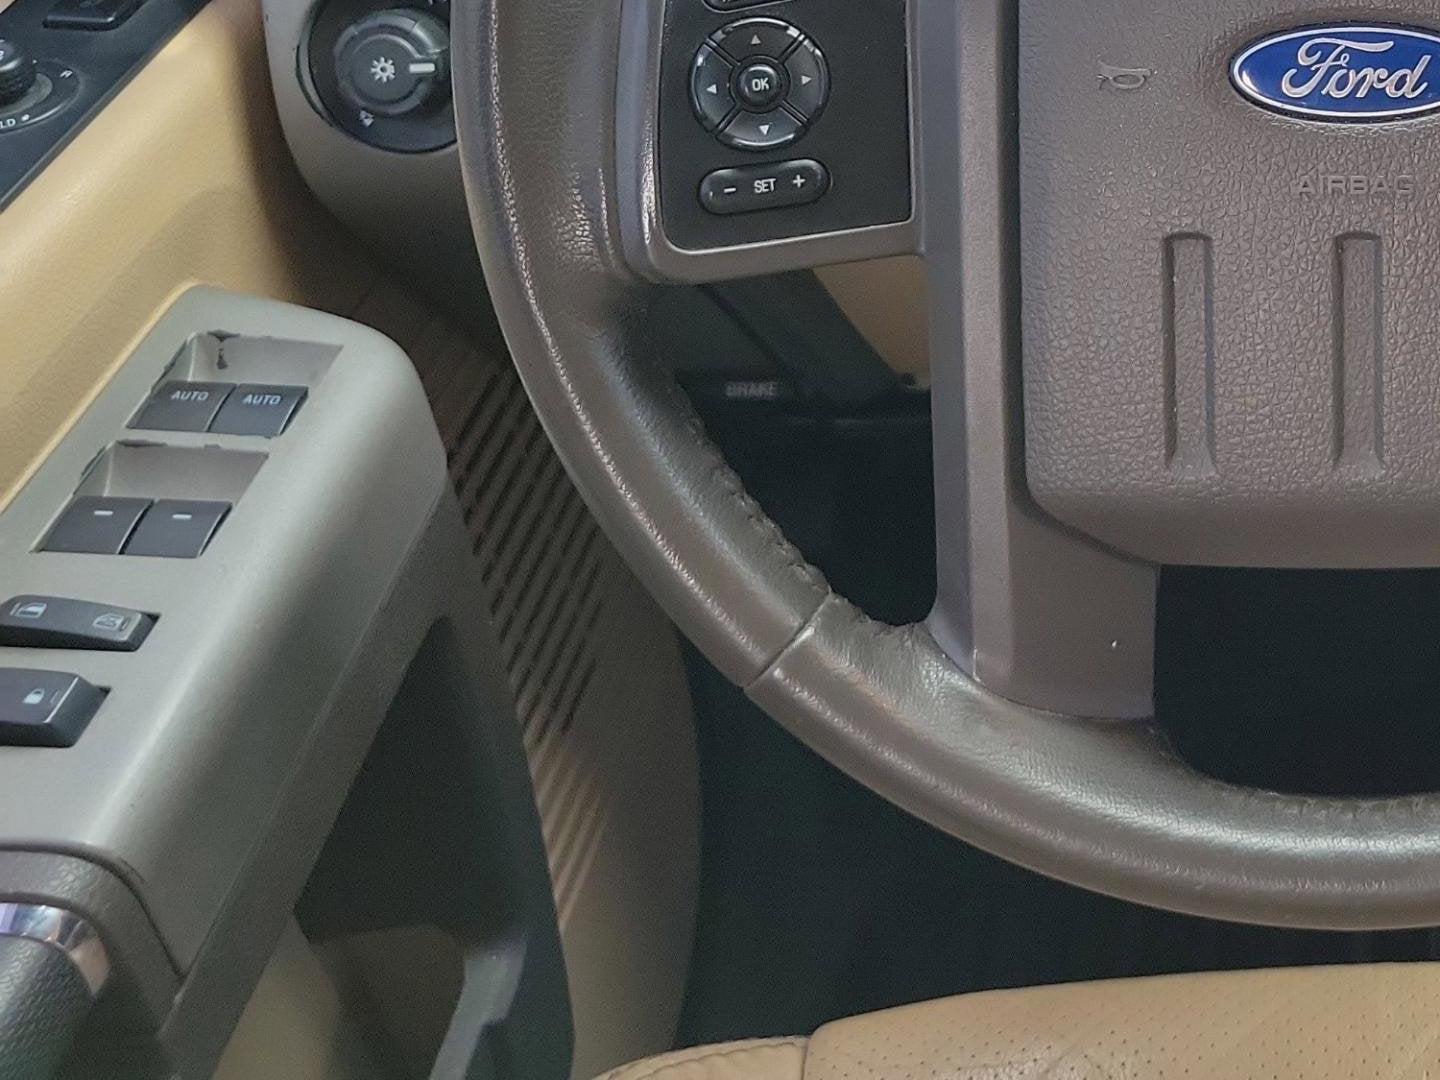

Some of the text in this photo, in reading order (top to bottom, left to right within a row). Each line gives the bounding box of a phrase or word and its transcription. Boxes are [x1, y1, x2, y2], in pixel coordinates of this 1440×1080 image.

[1281, 37, 1432, 100] Ford
[752, 78, 770, 92] OK
[0, 118, 16, 128] LD
[753, 178, 776, 193] SET
[1297, 175, 1416, 196] AIRBAG
[171, 391, 208, 401] AUTO
[243, 393, 281, 406] AUTO
